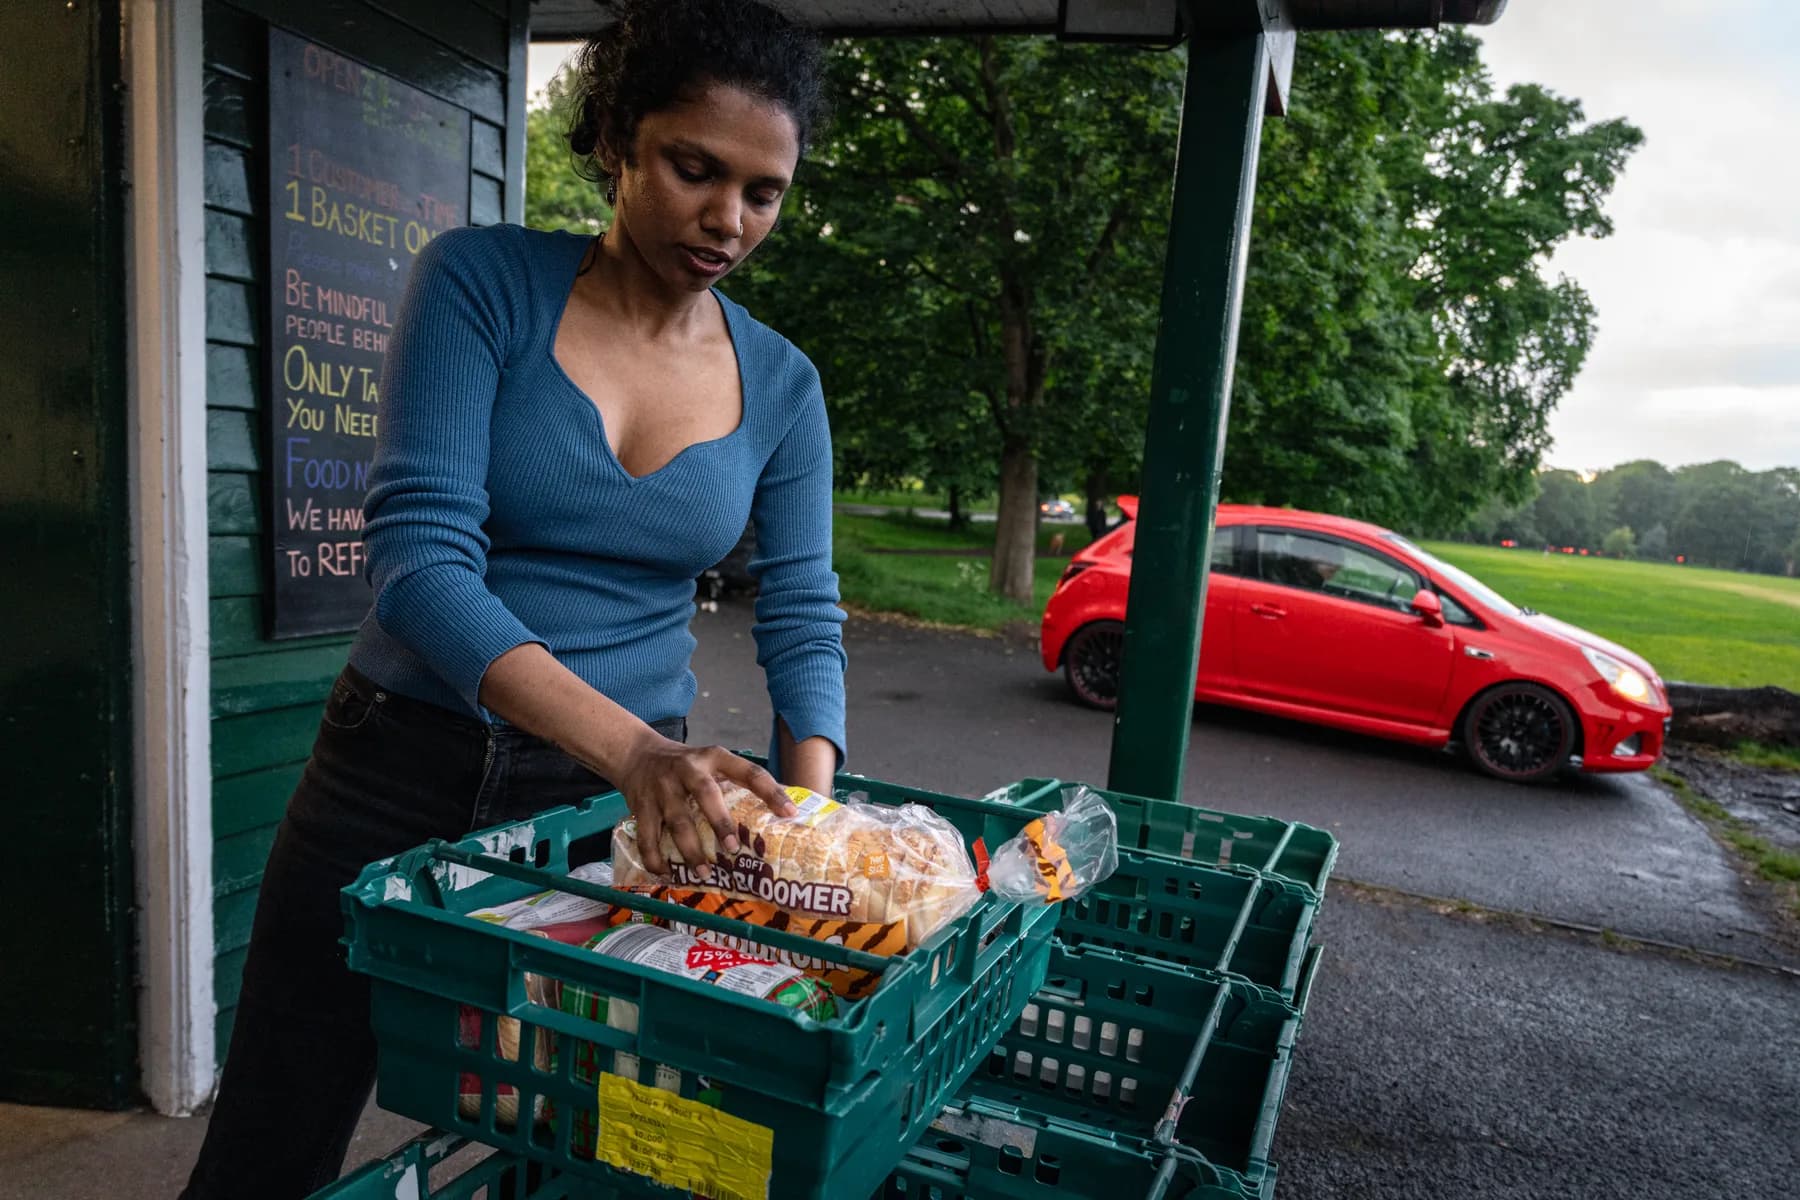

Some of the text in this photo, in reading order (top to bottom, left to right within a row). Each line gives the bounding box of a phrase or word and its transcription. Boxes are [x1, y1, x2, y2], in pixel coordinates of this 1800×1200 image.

[287, 144, 304, 180] 1
[285, 180, 305, 223] 1
[311, 186, 399, 249] BASKET
[285, 268, 392, 328] BE MINDFUL
[285, 315, 345, 346] PEOPLE
[283, 344, 354, 399] ONLY
[286, 437, 350, 490] FOOD
[287, 497, 365, 532] WE HAV
[317, 541, 367, 577] REF
[738, 856, 765, 872] SOFT
[732, 870, 851, 915] BLOOMER
[691, 950, 734, 964] 75%
